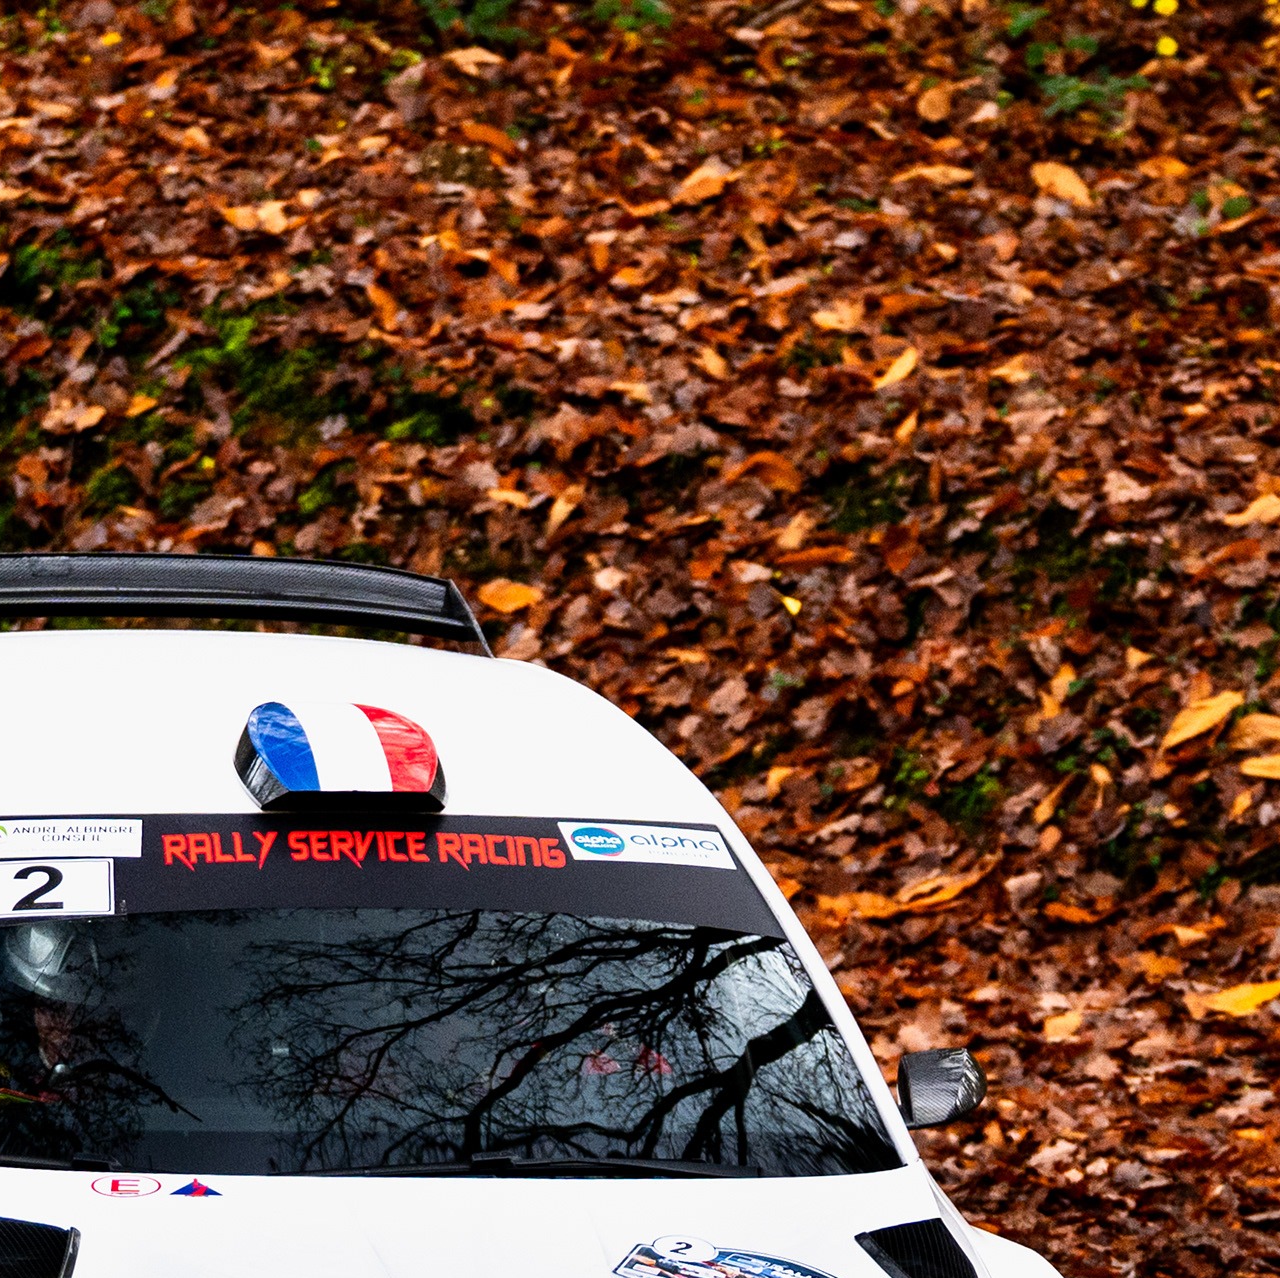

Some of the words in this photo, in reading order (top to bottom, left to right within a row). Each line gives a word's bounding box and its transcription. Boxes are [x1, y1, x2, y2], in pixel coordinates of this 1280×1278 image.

[162, 831, 278, 872] RALLY
[287, 831, 430, 869] SERVICE
[435, 832, 567, 871] RACING
[630, 834, 719, 851] alpha
[12, 865, 64, 911] 2
[669, 1241, 693, 1256] 2
